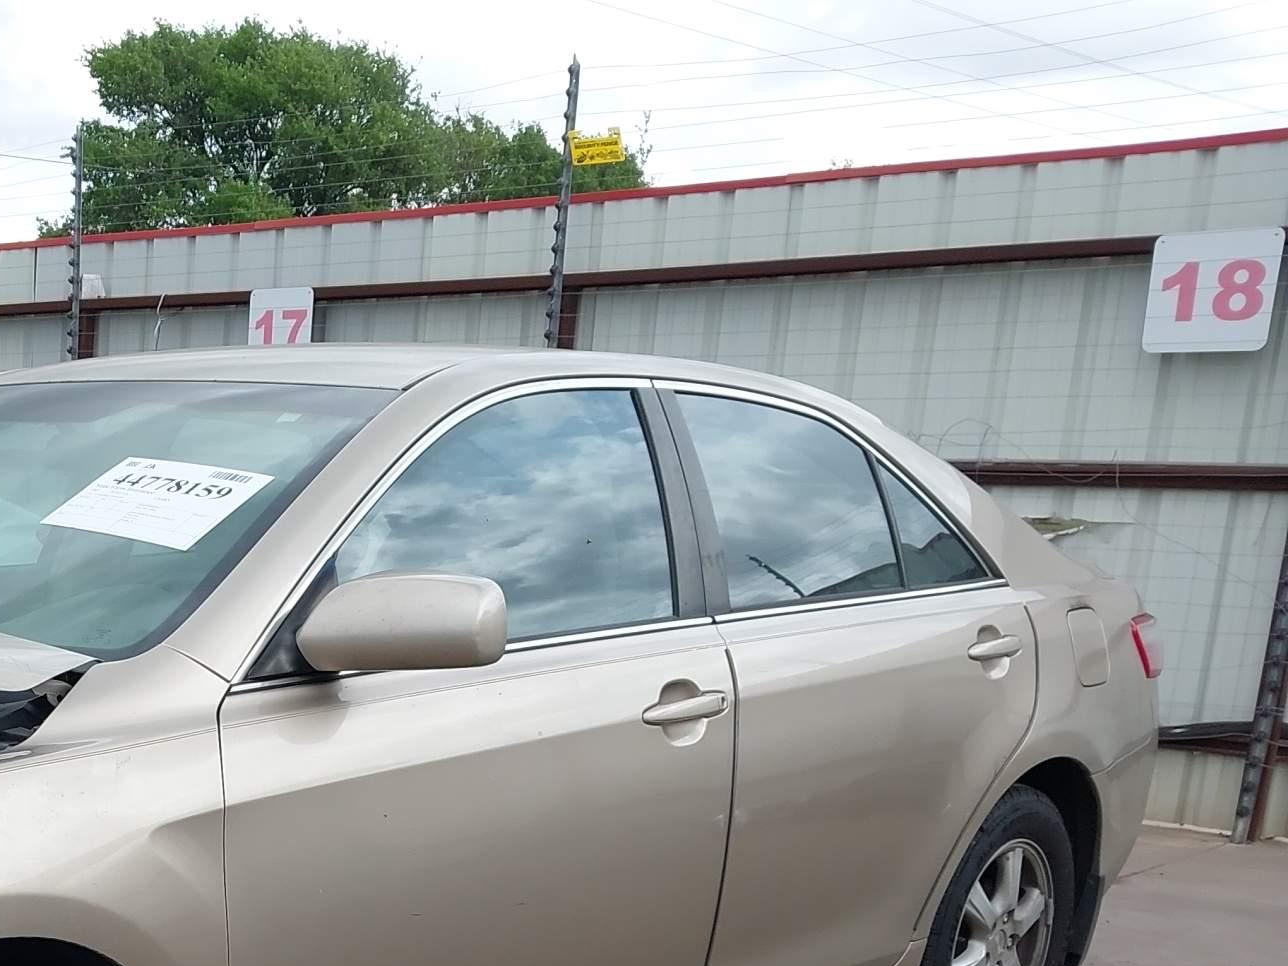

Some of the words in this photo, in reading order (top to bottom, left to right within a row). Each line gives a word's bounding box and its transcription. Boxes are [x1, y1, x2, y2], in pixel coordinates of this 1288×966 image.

[1161, 258, 1266, 322] 18
[255, 308, 308, 345] 17
[112, 472, 233, 500] 44778159
